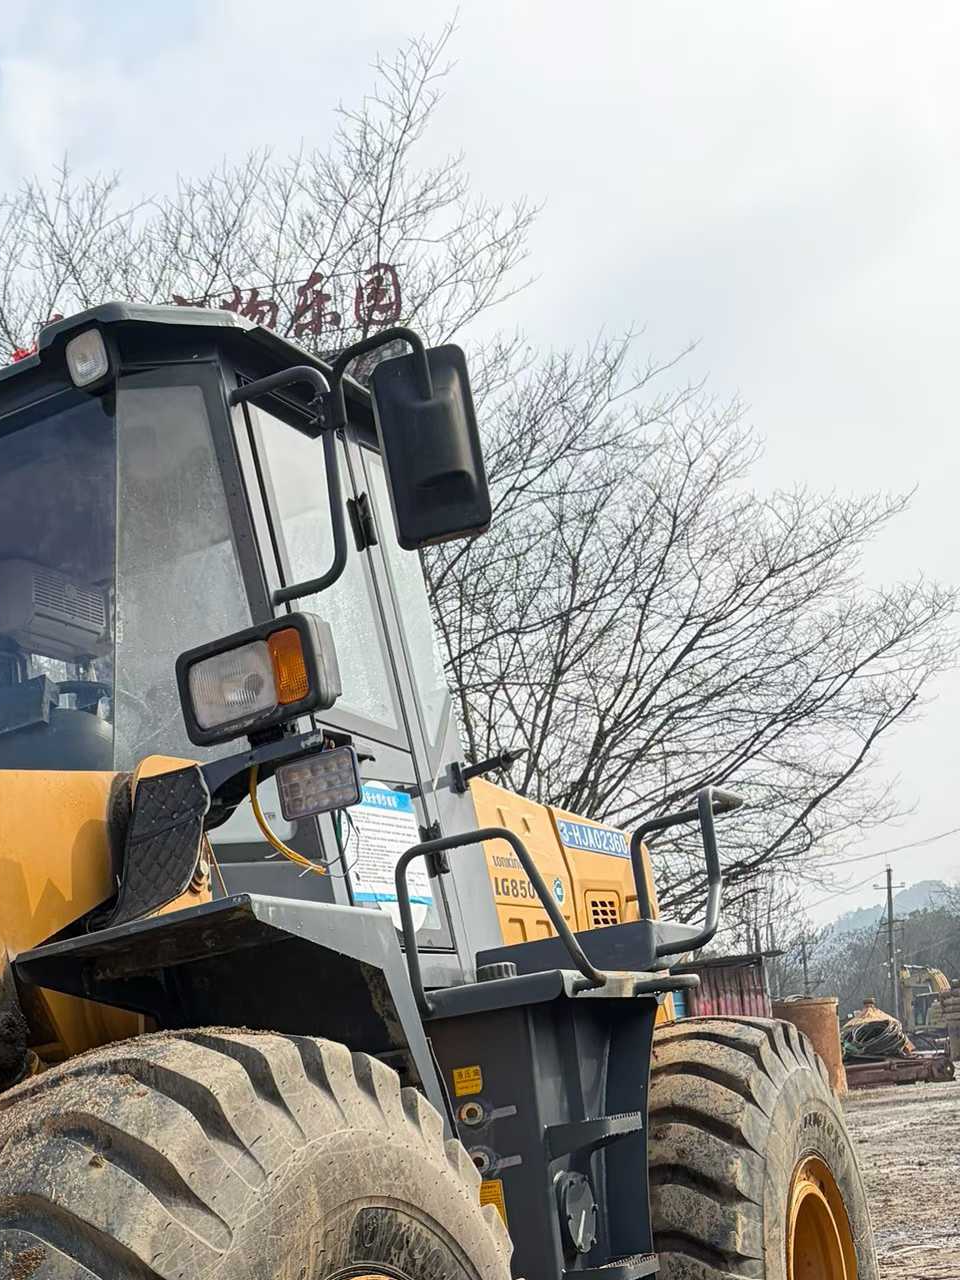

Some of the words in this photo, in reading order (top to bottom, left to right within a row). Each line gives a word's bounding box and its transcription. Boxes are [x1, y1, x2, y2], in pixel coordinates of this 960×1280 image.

[172, 263, 402, 338] 物乐园
[492, 853, 524, 870] LONKIN
